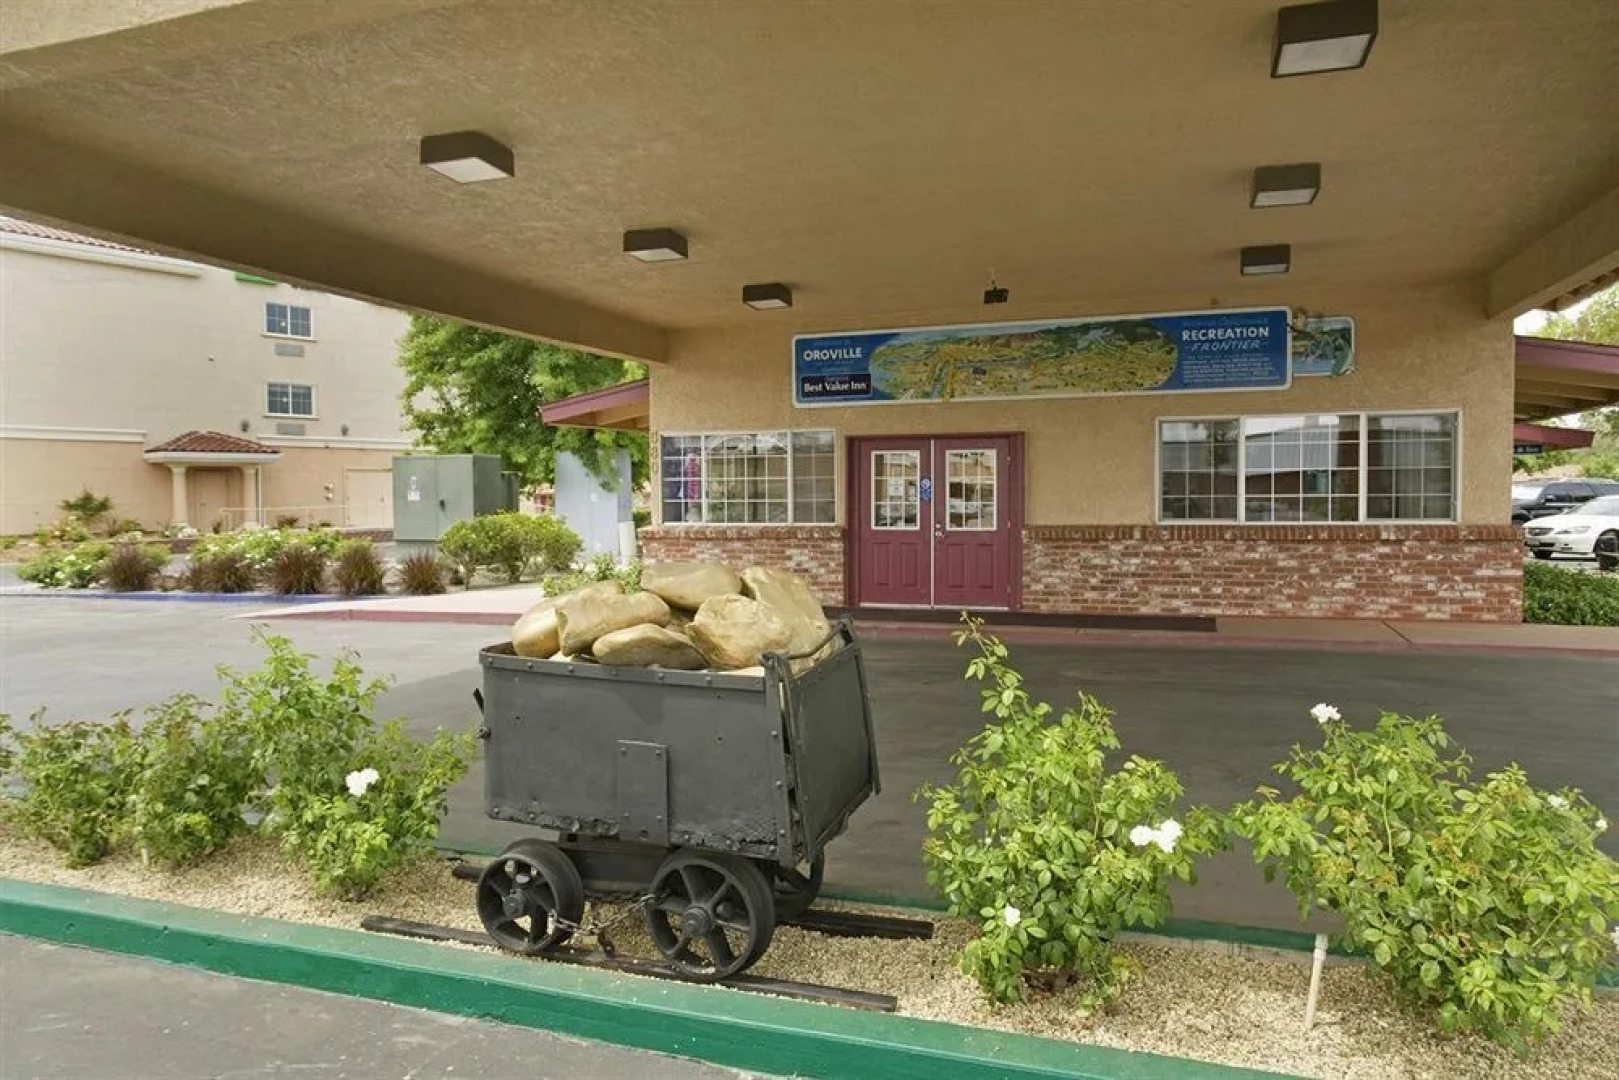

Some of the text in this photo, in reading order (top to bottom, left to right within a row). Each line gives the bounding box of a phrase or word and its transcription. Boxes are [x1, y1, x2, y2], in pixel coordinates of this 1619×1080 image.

[1181, 326, 1270, 341] RECREATION
[1191, 339, 1261, 352] FRONTIER
[803, 347, 862, 361] OROVILLE
[804, 380, 867, 393] Best Value Inn
